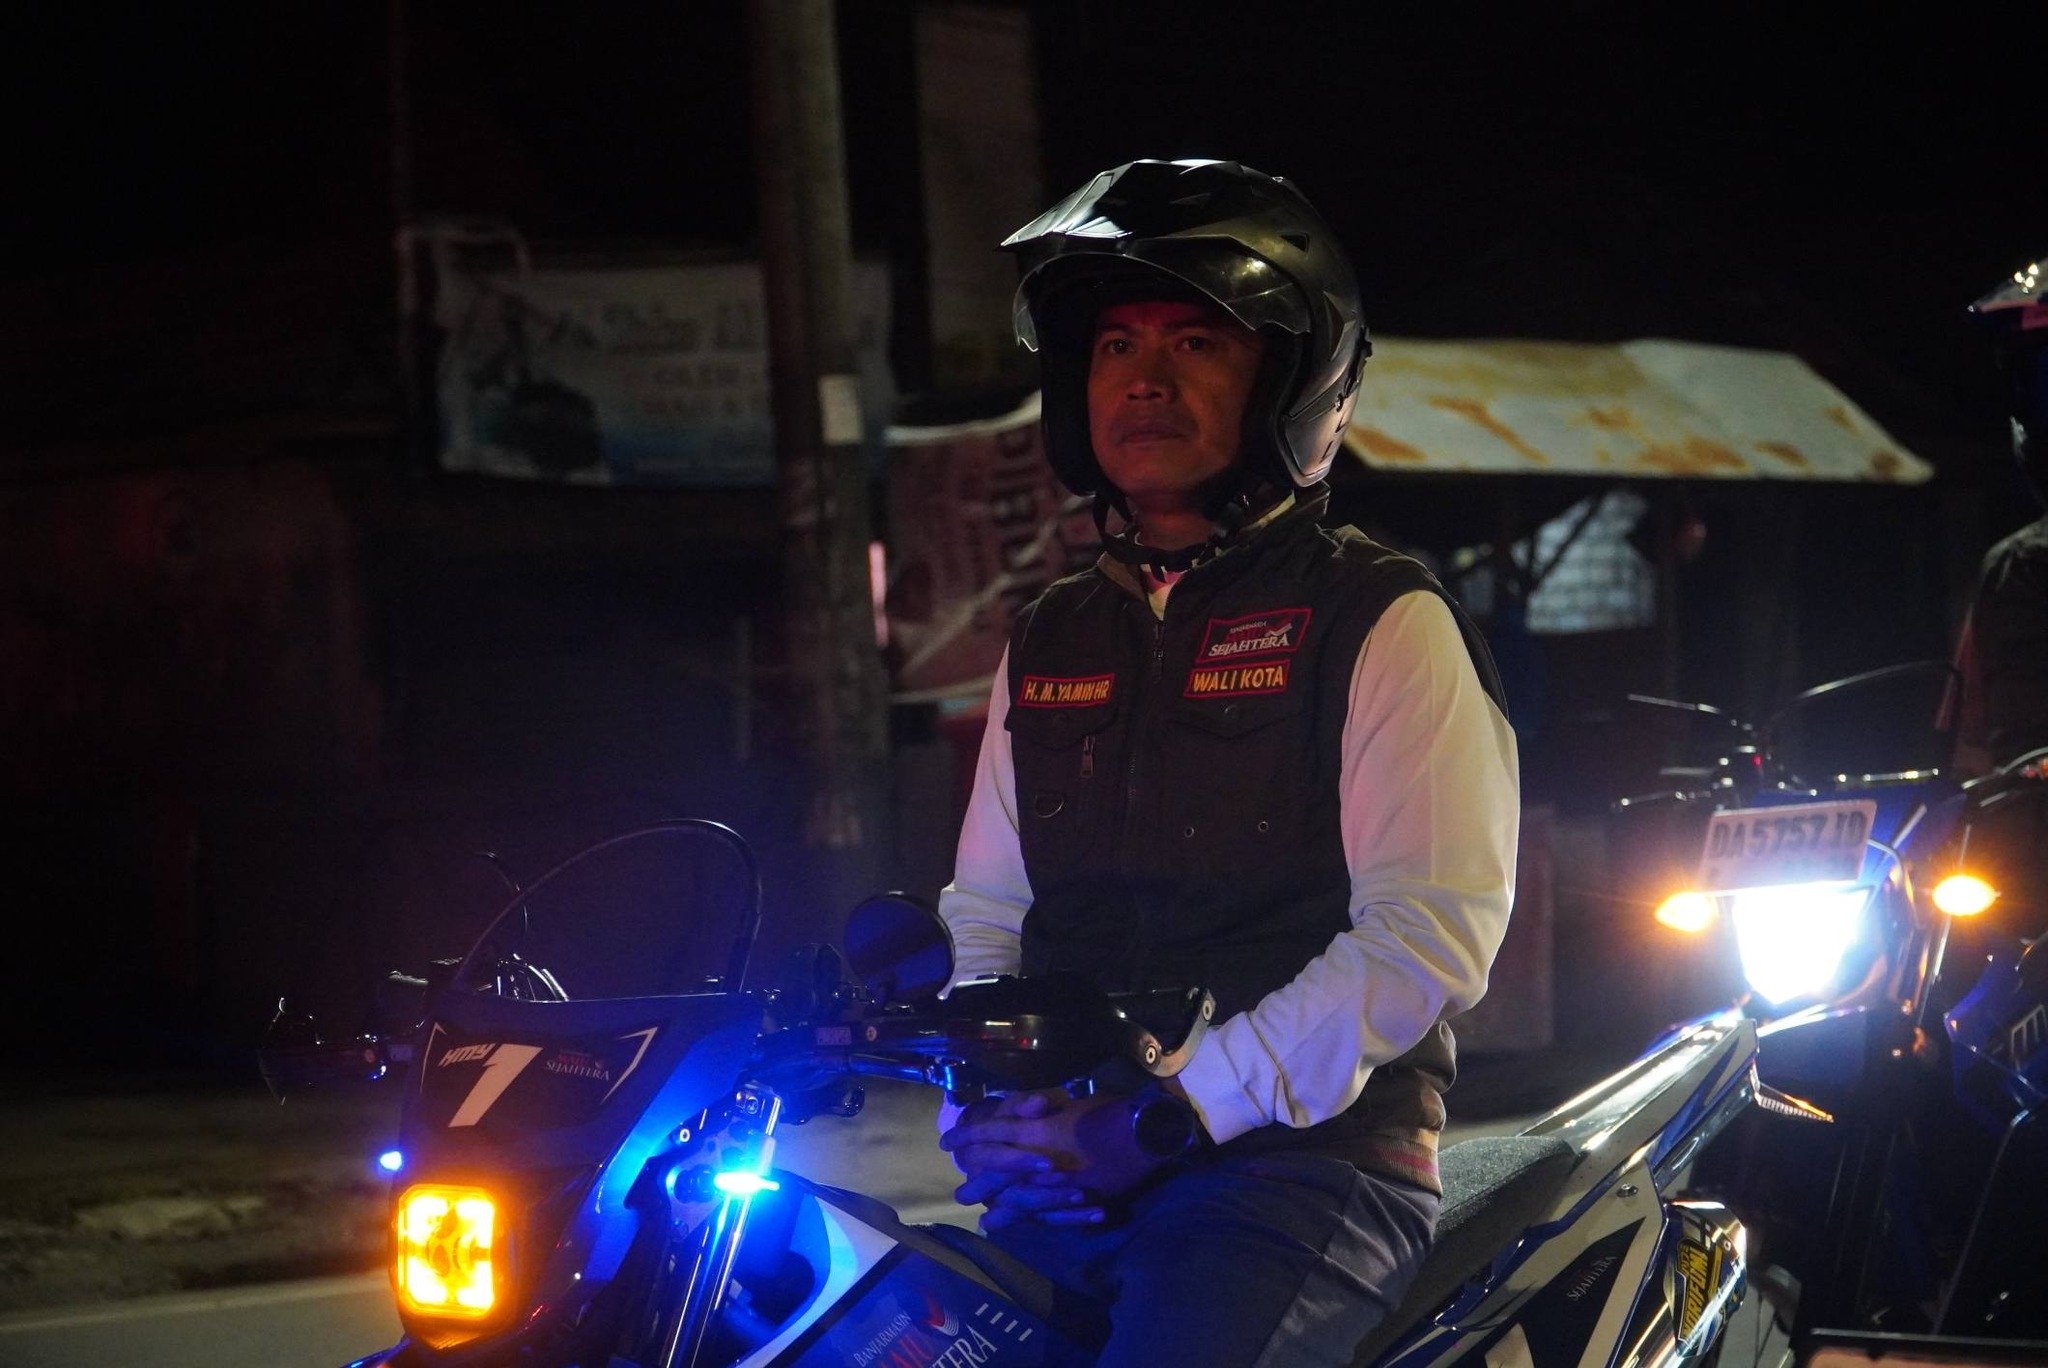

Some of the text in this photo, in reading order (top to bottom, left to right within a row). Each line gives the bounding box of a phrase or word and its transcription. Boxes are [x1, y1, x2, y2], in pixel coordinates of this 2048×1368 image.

[1193, 665, 1284, 692] WALI KOTA
[437, 1043, 496, 1067] HMY
[448, 1043, 543, 1127] 1
[853, 1310, 913, 1368] BANJARMASIN
